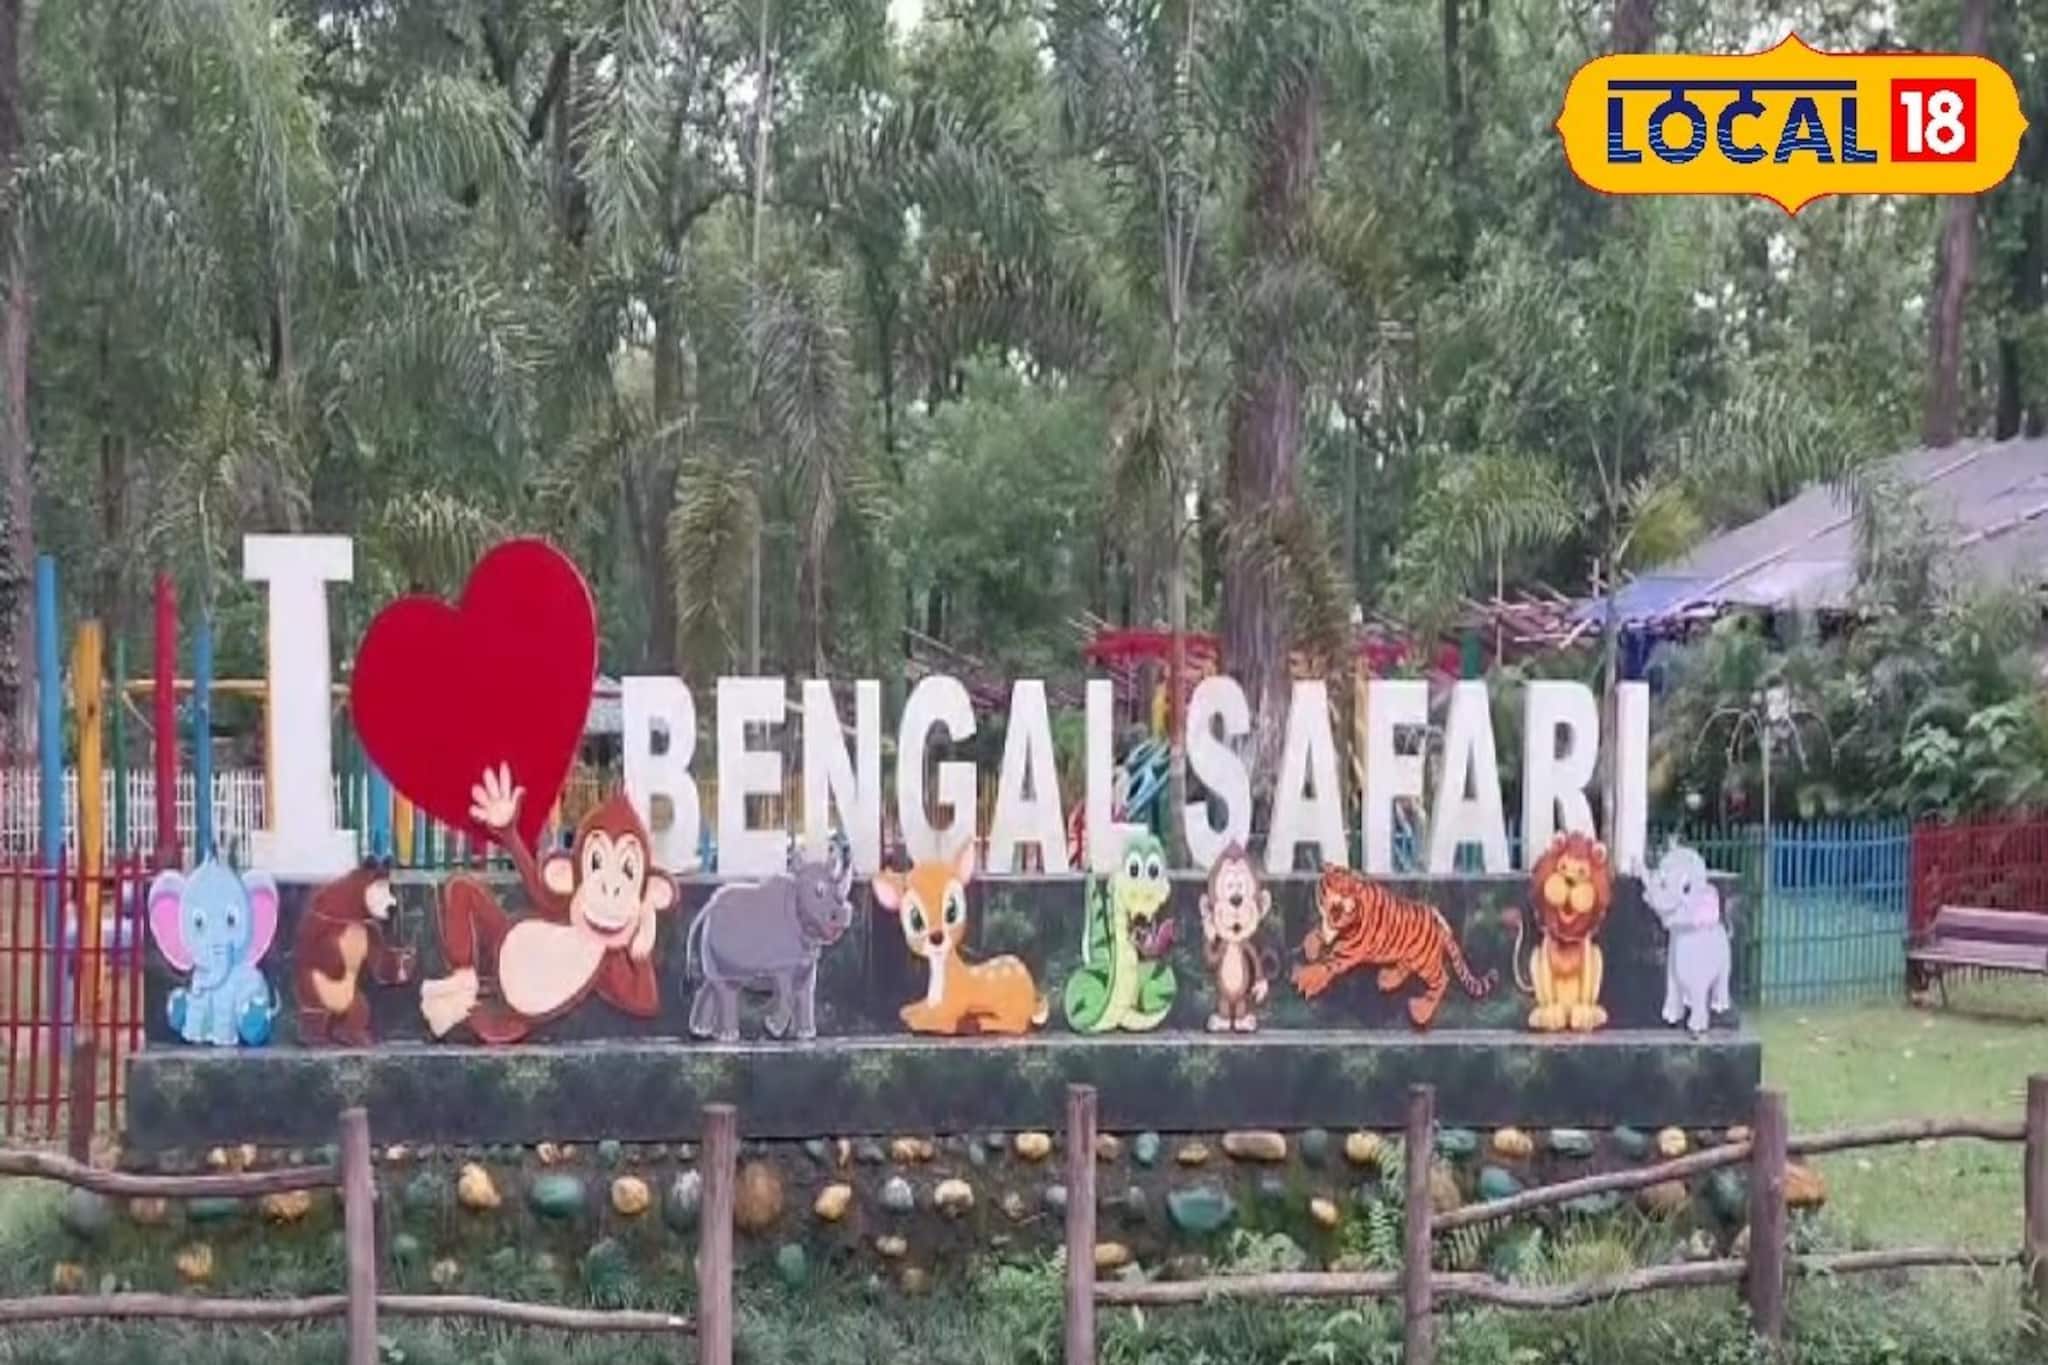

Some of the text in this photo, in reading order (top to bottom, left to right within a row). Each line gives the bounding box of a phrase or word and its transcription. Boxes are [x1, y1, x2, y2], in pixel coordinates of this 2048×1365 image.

[243, 535, 1650, 877] I BENGAL SAFARI
